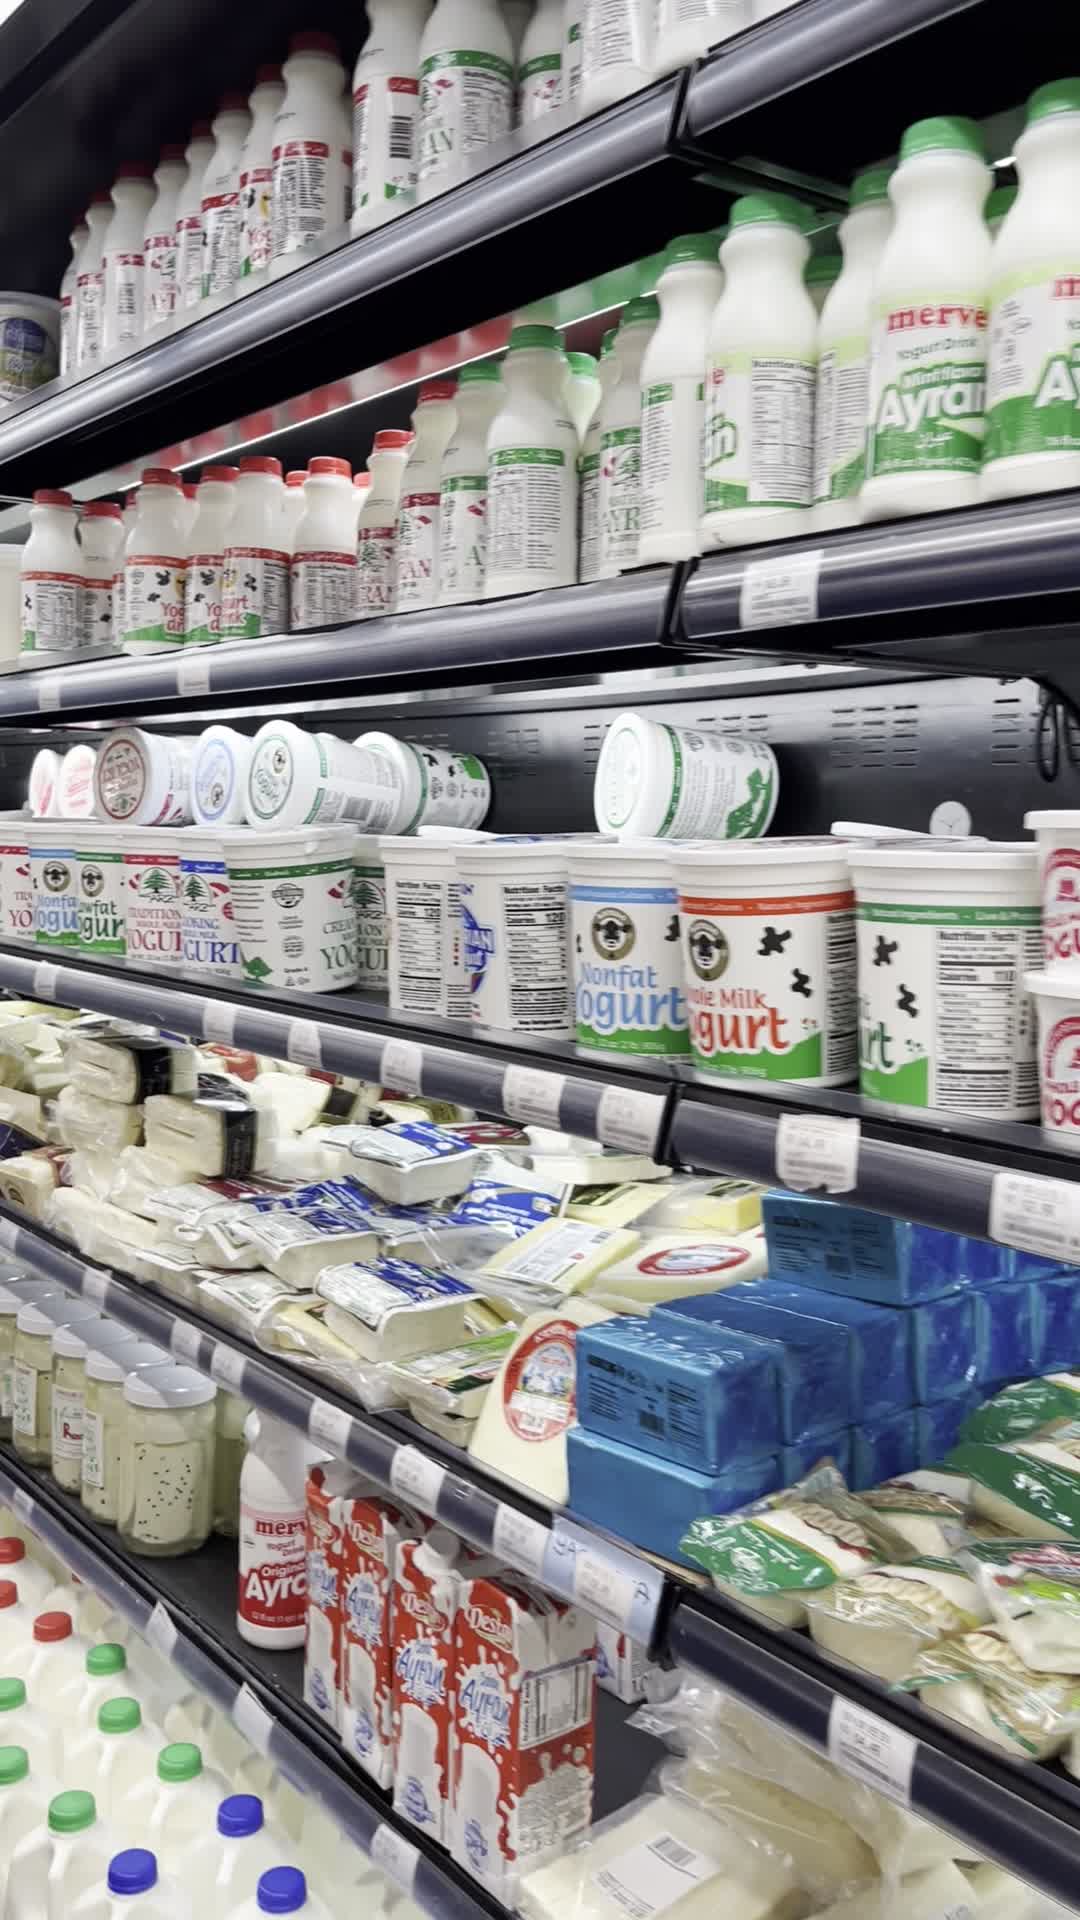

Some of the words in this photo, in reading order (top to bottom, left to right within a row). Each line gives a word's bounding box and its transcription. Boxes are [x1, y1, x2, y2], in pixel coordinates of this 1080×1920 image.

[888, 305, 988, 332] merve
[580, 962, 659, 991] Nonfat
[719, 988, 769, 1009] Milk
